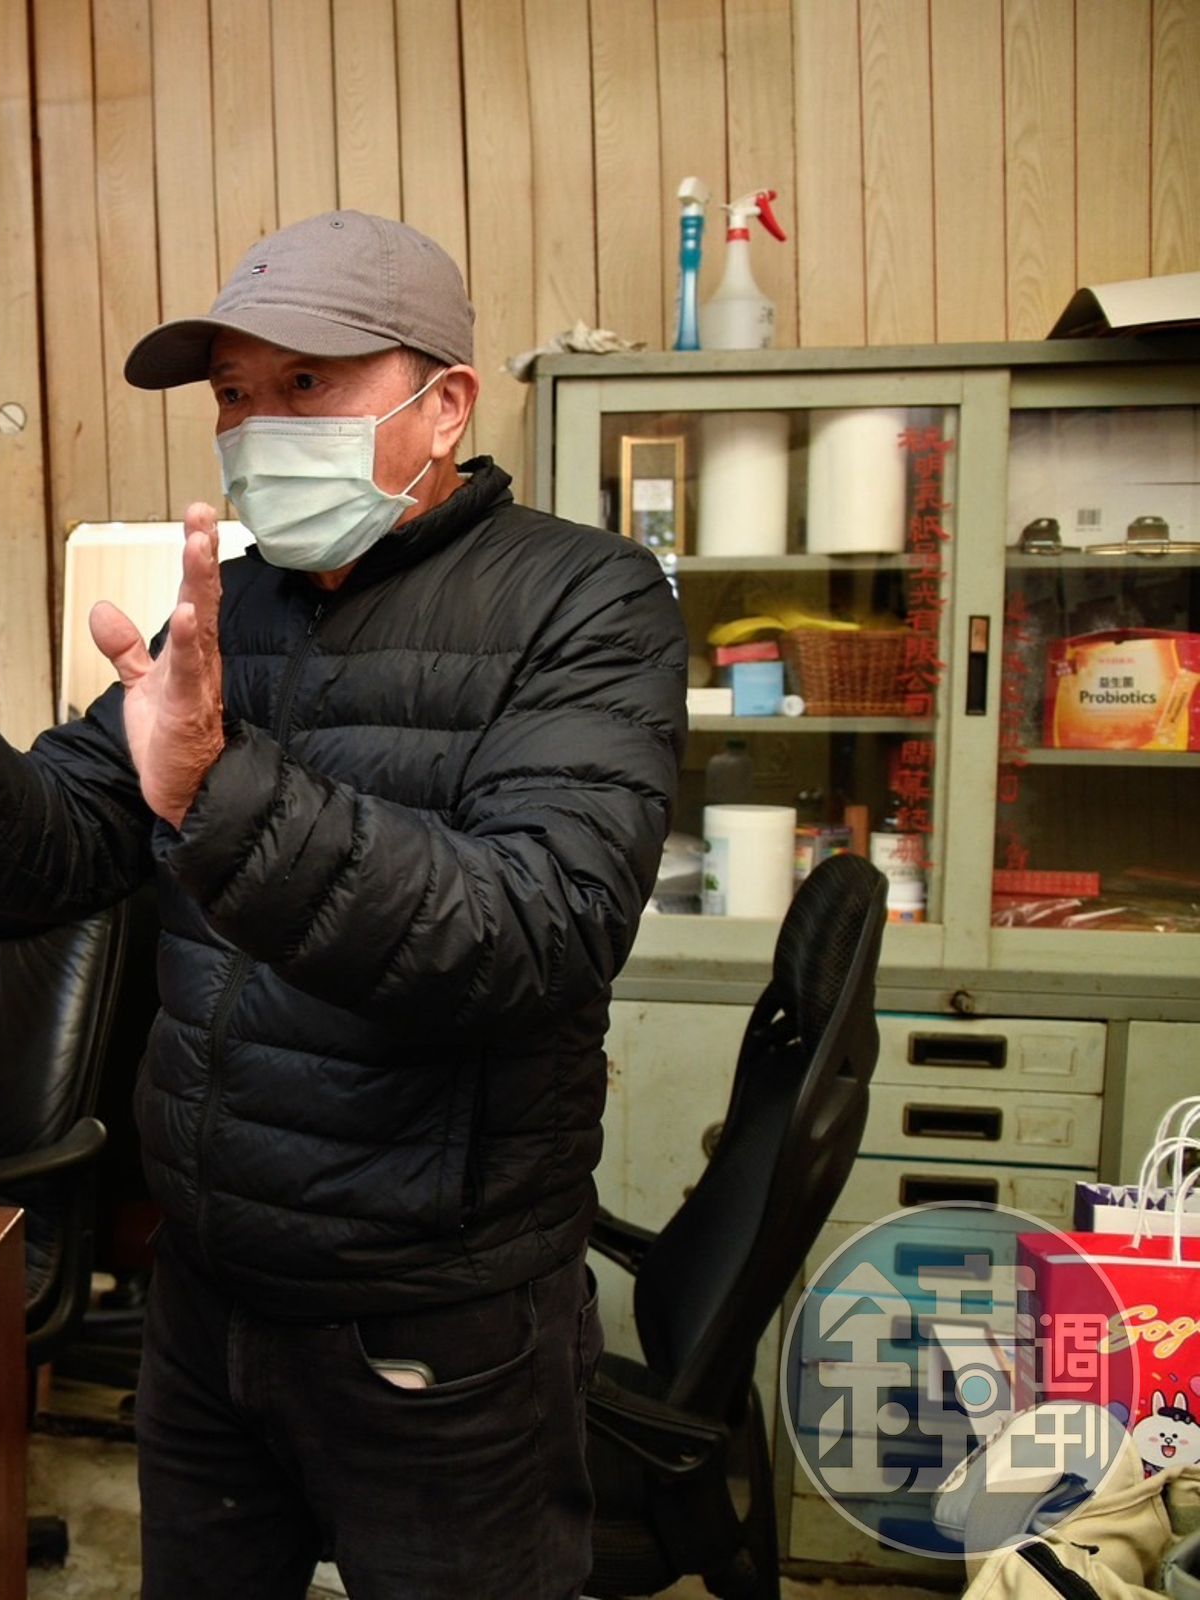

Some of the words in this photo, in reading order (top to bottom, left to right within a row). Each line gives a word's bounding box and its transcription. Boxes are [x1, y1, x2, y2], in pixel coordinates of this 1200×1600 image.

[1099, 676, 1135, 689] 益生菌
[1079, 690, 1157, 704] Probiotics
[1097, 1303, 1200, 1359] Sog
